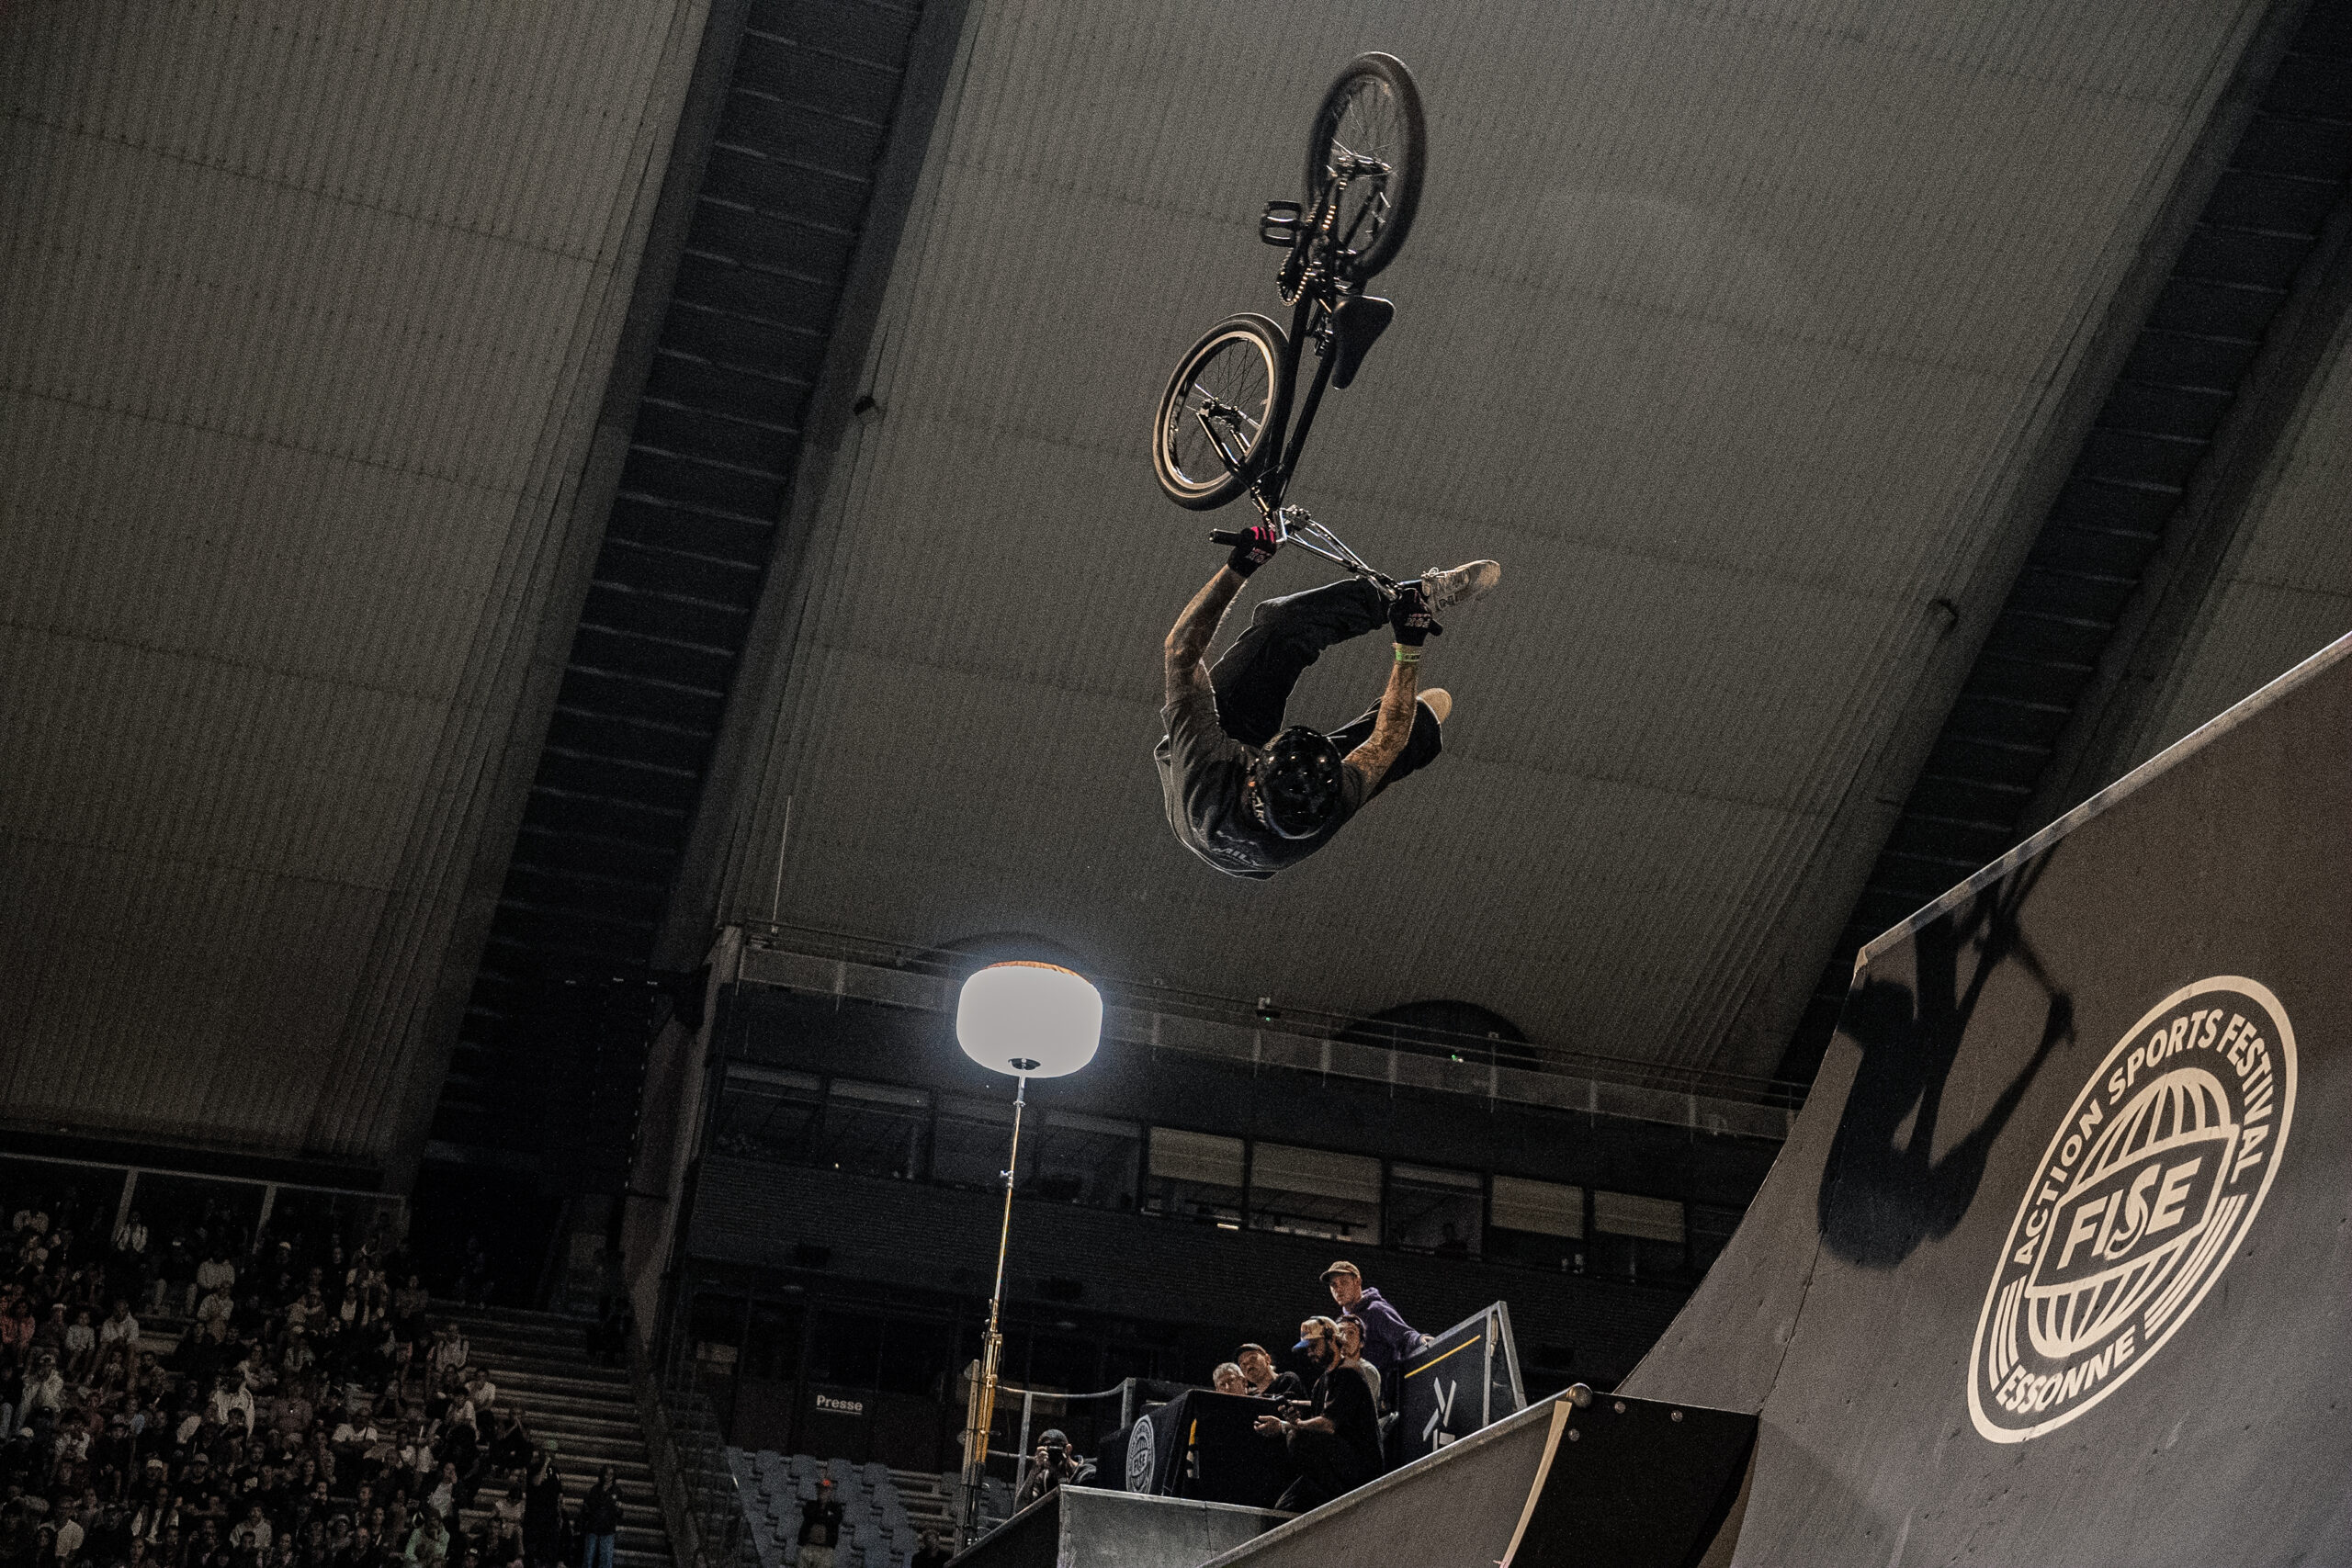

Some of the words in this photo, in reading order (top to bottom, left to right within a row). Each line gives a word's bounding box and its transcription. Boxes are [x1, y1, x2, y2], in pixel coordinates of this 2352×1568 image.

[2013, 1098, 2104, 1265] ACTION
[2108, 1009, 2223, 1105] SPORTS
[2216, 1013, 2274, 1184] FESTIVAL
[2056, 1156, 2202, 1270] FISE
[816, 1394, 863, 1411] Presse
[1995, 1324, 2136, 1414] ESSONNE
